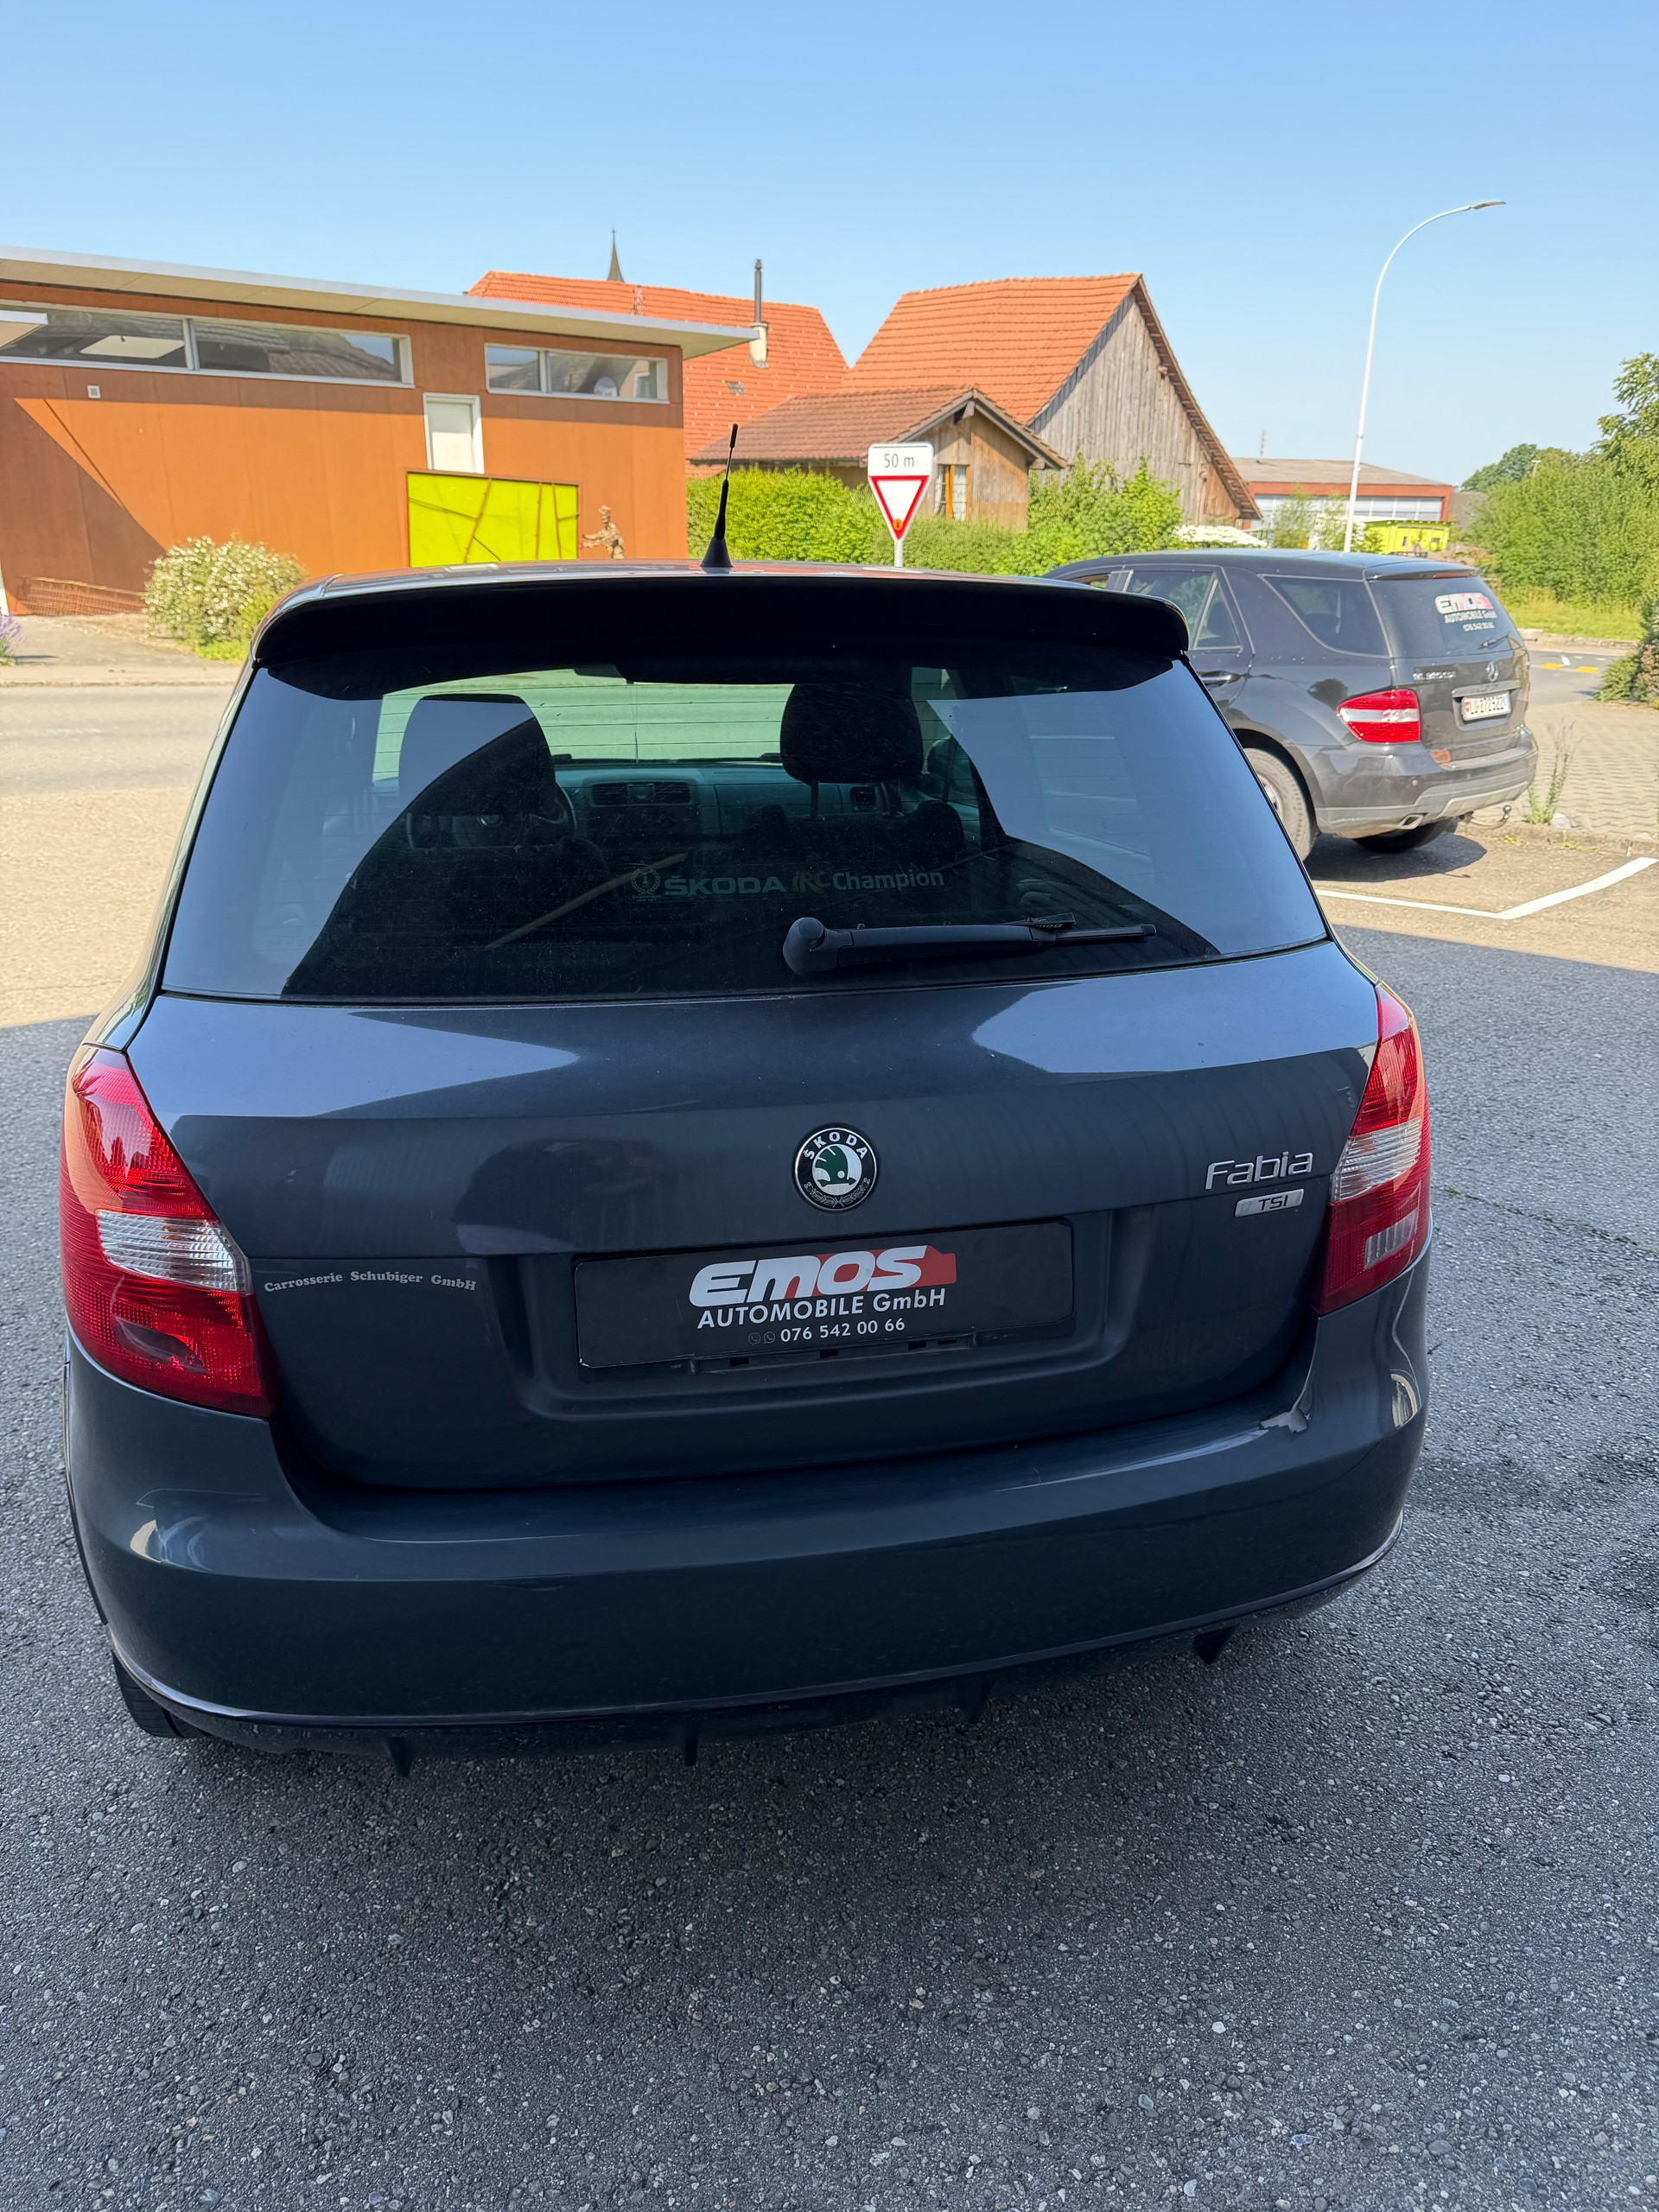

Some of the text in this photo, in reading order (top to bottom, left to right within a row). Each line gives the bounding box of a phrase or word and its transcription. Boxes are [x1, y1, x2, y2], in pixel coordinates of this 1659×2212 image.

[884, 454, 915, 468] 50 m
[1435, 593, 1489, 614] EMOS
[664, 874, 786, 896] ŠKODA
[833, 869, 944, 892] Champion
[1205, 1151, 1313, 1190] Fabia
[1258, 1195, 1288, 1211] TSI
[264, 1270, 476, 1293] Carrosserie Schubiger GmbH
[689, 1245, 928, 1307] EMOS
[696, 1287, 945, 1329] AUTOMOBILE GmbH
[780, 1317, 906, 1343] 076 542 00 66
